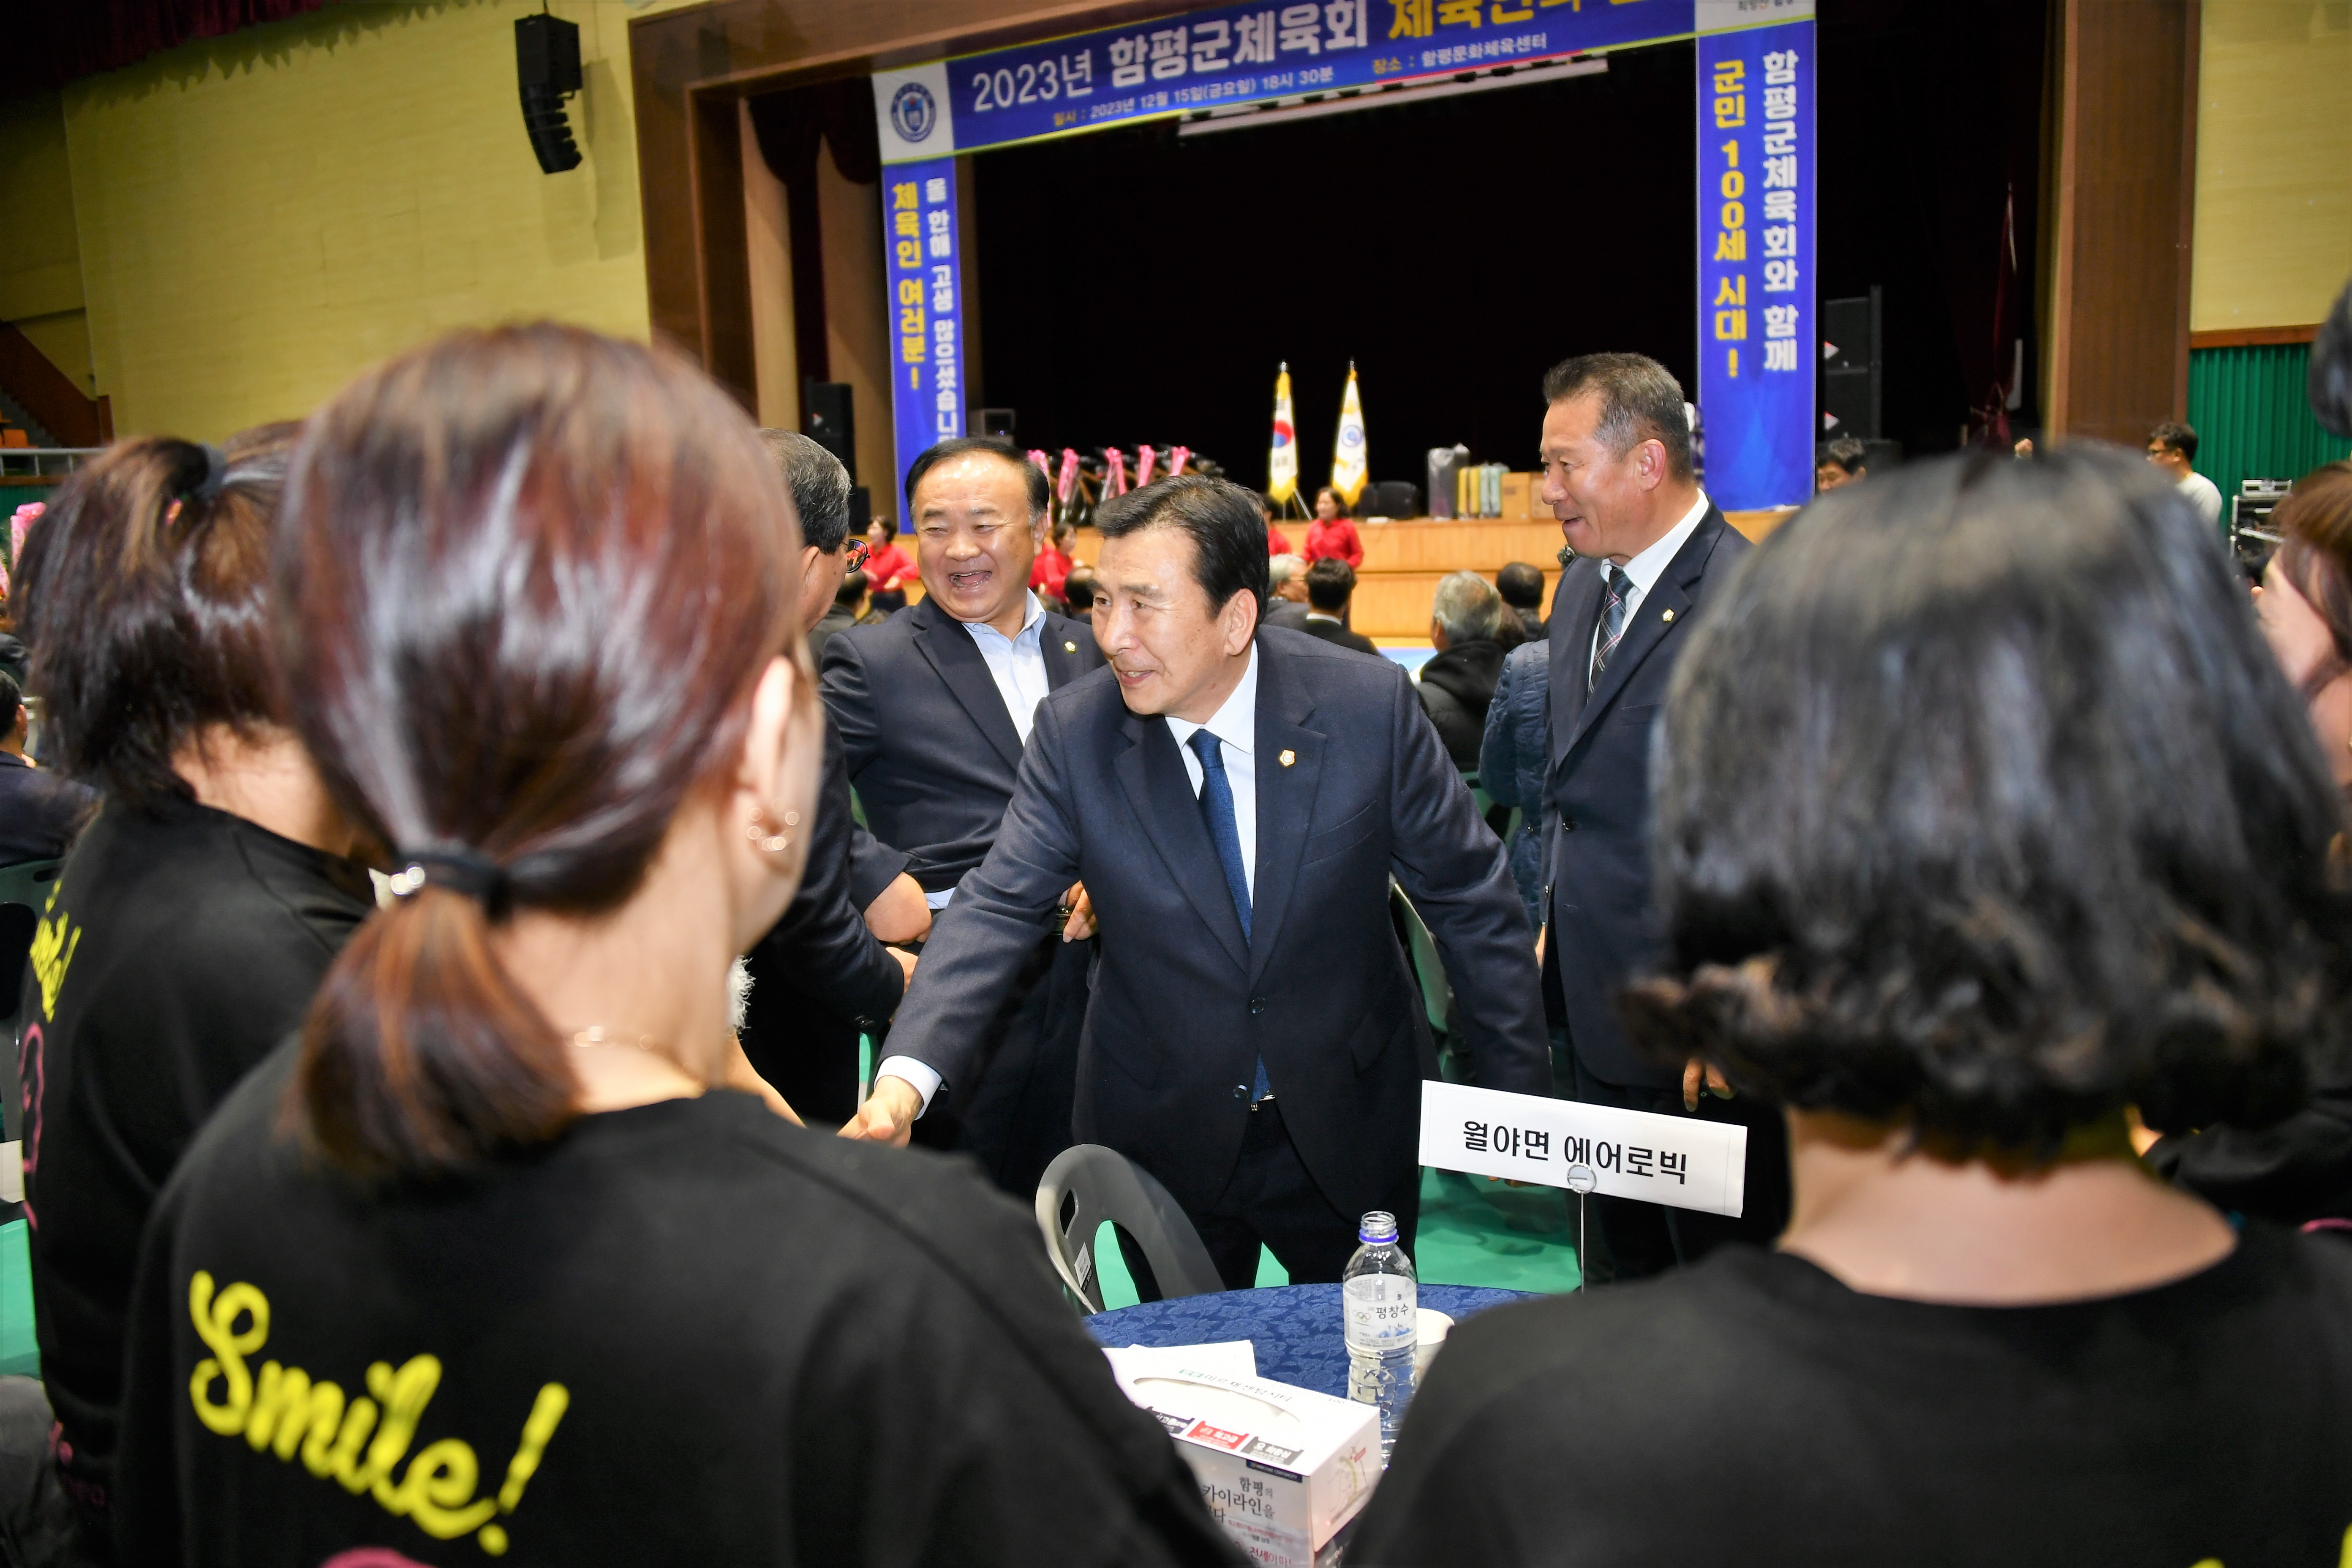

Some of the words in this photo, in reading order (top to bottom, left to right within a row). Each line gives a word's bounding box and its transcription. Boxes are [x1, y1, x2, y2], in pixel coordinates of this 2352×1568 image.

[972, 49, 1093, 112] 2023년
[1109, 0, 1369, 88] 함평군체육회
[1388, 0, 1581, 39] 체육
[1090, 98, 1135, 119] 2023년
[1141, 91, 1169, 109] 12월
[1175, 78, 1256, 103] 15일(금요일)
[1263, 72, 1294, 91] 18시
[1299, 66, 1334, 85] 30분
[1372, 57, 1403, 74] 장소
[1421, 32, 1548, 68] 함평문화체육센터
[1714, 59, 1746, 129] 군민
[926, 177, 947, 202] 올
[1713, 139, 1747, 263] 100세
[1762, 49, 1799, 293] 함평군체육회와
[892, 182, 922, 268] 체육인
[928, 210, 950, 257] 한해
[1763, 303, 1799, 371] 함께
[1463, 1120, 1549, 1161] 월야면
[1564, 1135, 1687, 1185] 에어로빅
[1376, 1303, 1409, 1320] 평창수
[189, 1270, 570, 1556] Smile!
[1239, 1476, 1273, 1499] 함평의
